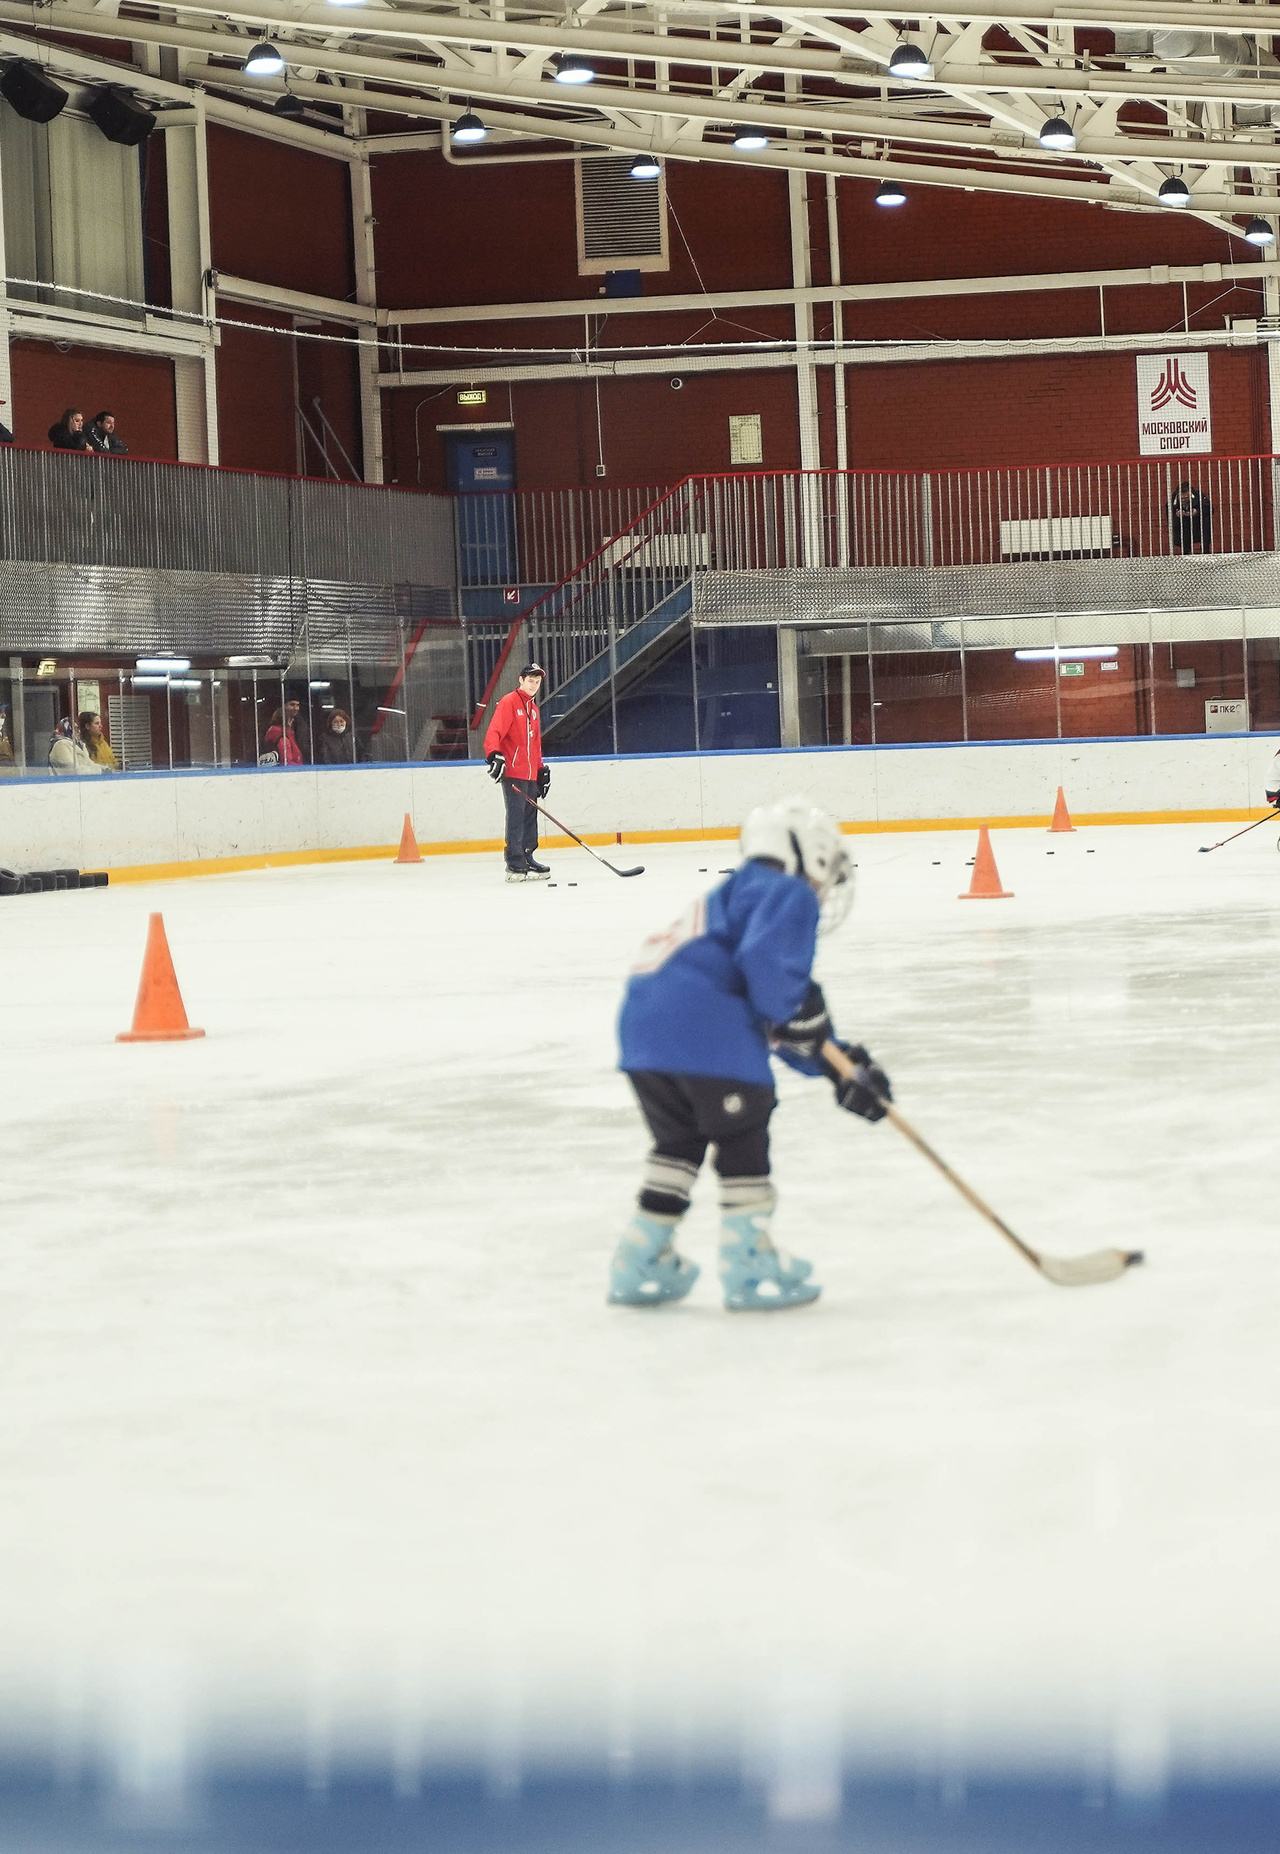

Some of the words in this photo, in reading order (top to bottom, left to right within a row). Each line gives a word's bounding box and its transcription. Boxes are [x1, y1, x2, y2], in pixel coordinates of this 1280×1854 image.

[459, 392, 482, 401] ВЫХОД
[1142, 417, 1208, 435] МОСКОВСКИЙ
[1160, 436, 1190, 450] СПОРТ
